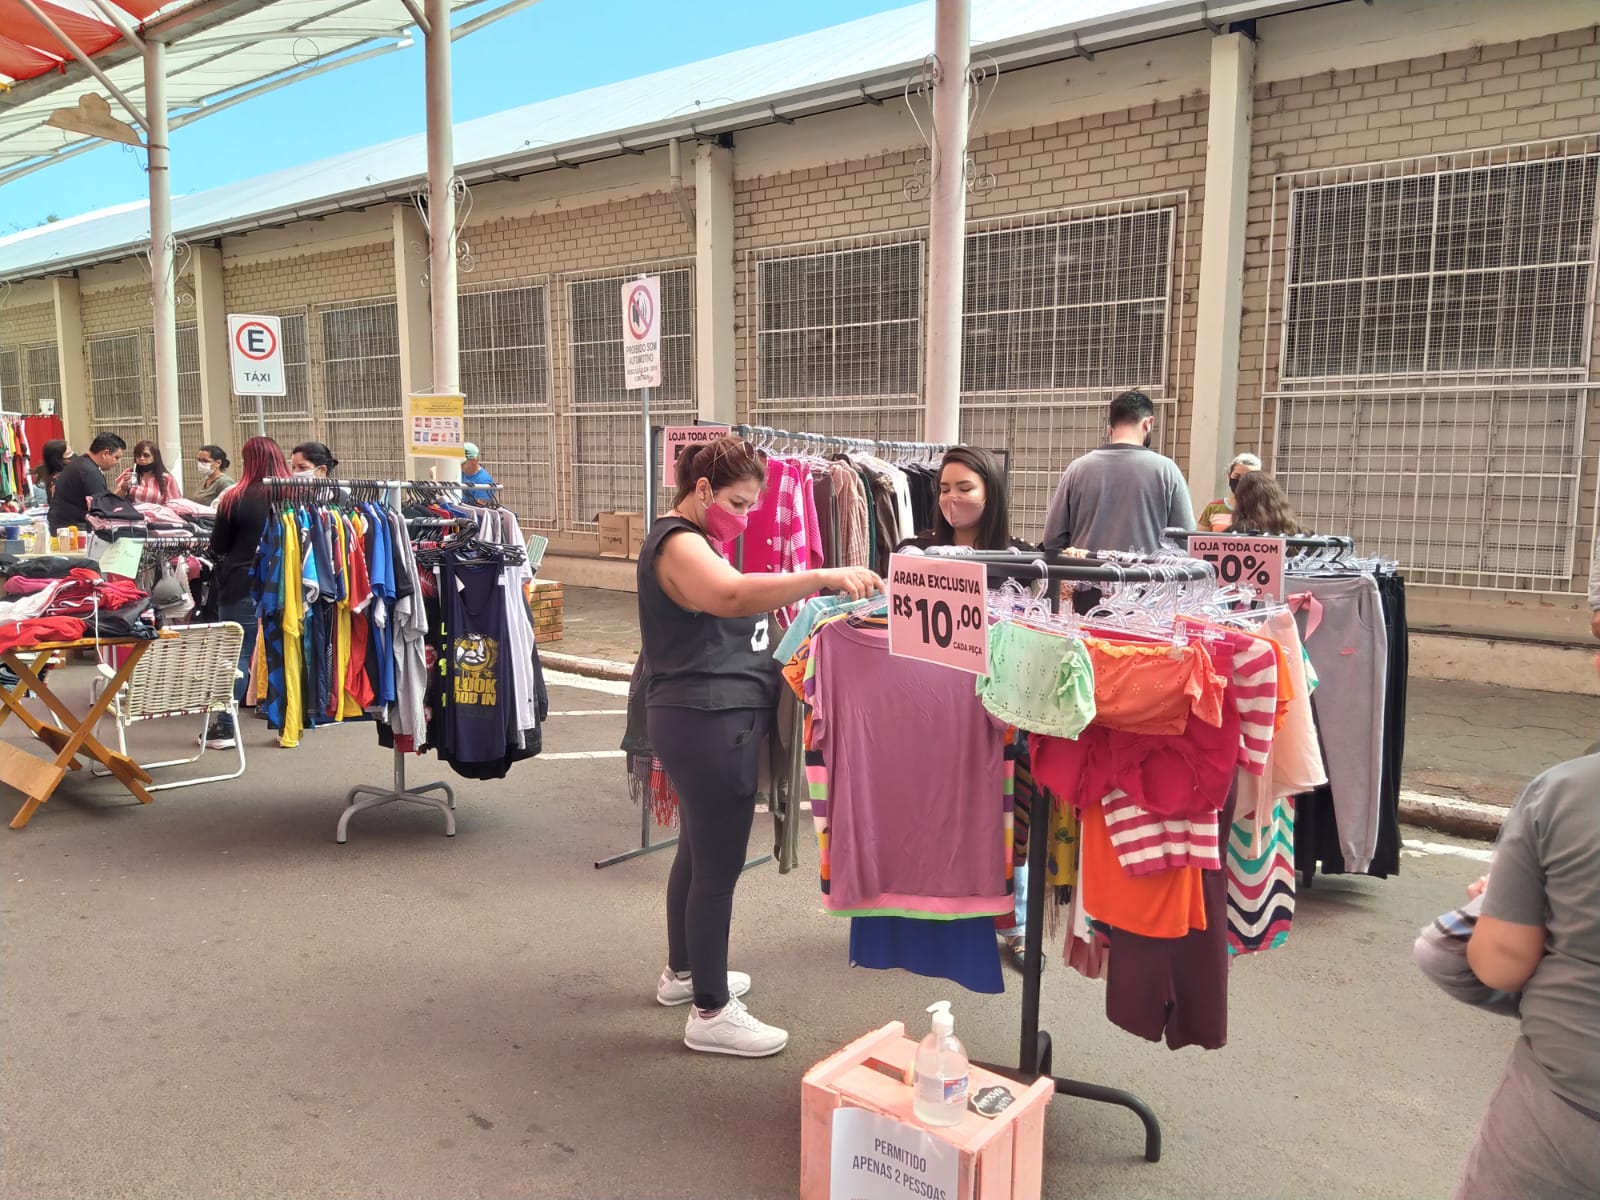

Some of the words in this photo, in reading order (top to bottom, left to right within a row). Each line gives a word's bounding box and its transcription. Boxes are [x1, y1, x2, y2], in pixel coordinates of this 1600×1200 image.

[247, 329, 266, 353] E
[243, 370, 271, 382] TÁXI
[668, 432, 686, 441] LOJA
[687, 432, 708, 441] TODA
[1193, 542, 1220, 551] LOJA
[1222, 542, 1251, 552] TODA
[1253, 543, 1279, 554] COM
[893, 570, 926, 587] ARARA
[927, 574, 981, 595] EXCLUSIVA
[893, 593, 913, 620] R$
[953, 641, 968, 651] CADA
[968, 645, 982, 656] PEÇA
[874, 1138, 927, 1173] PERMITIDO
[852, 1155, 892, 1180] APENAS
[894, 1169, 901, 1184] 2
[903, 1173, 946, 1200] PESSOAS
